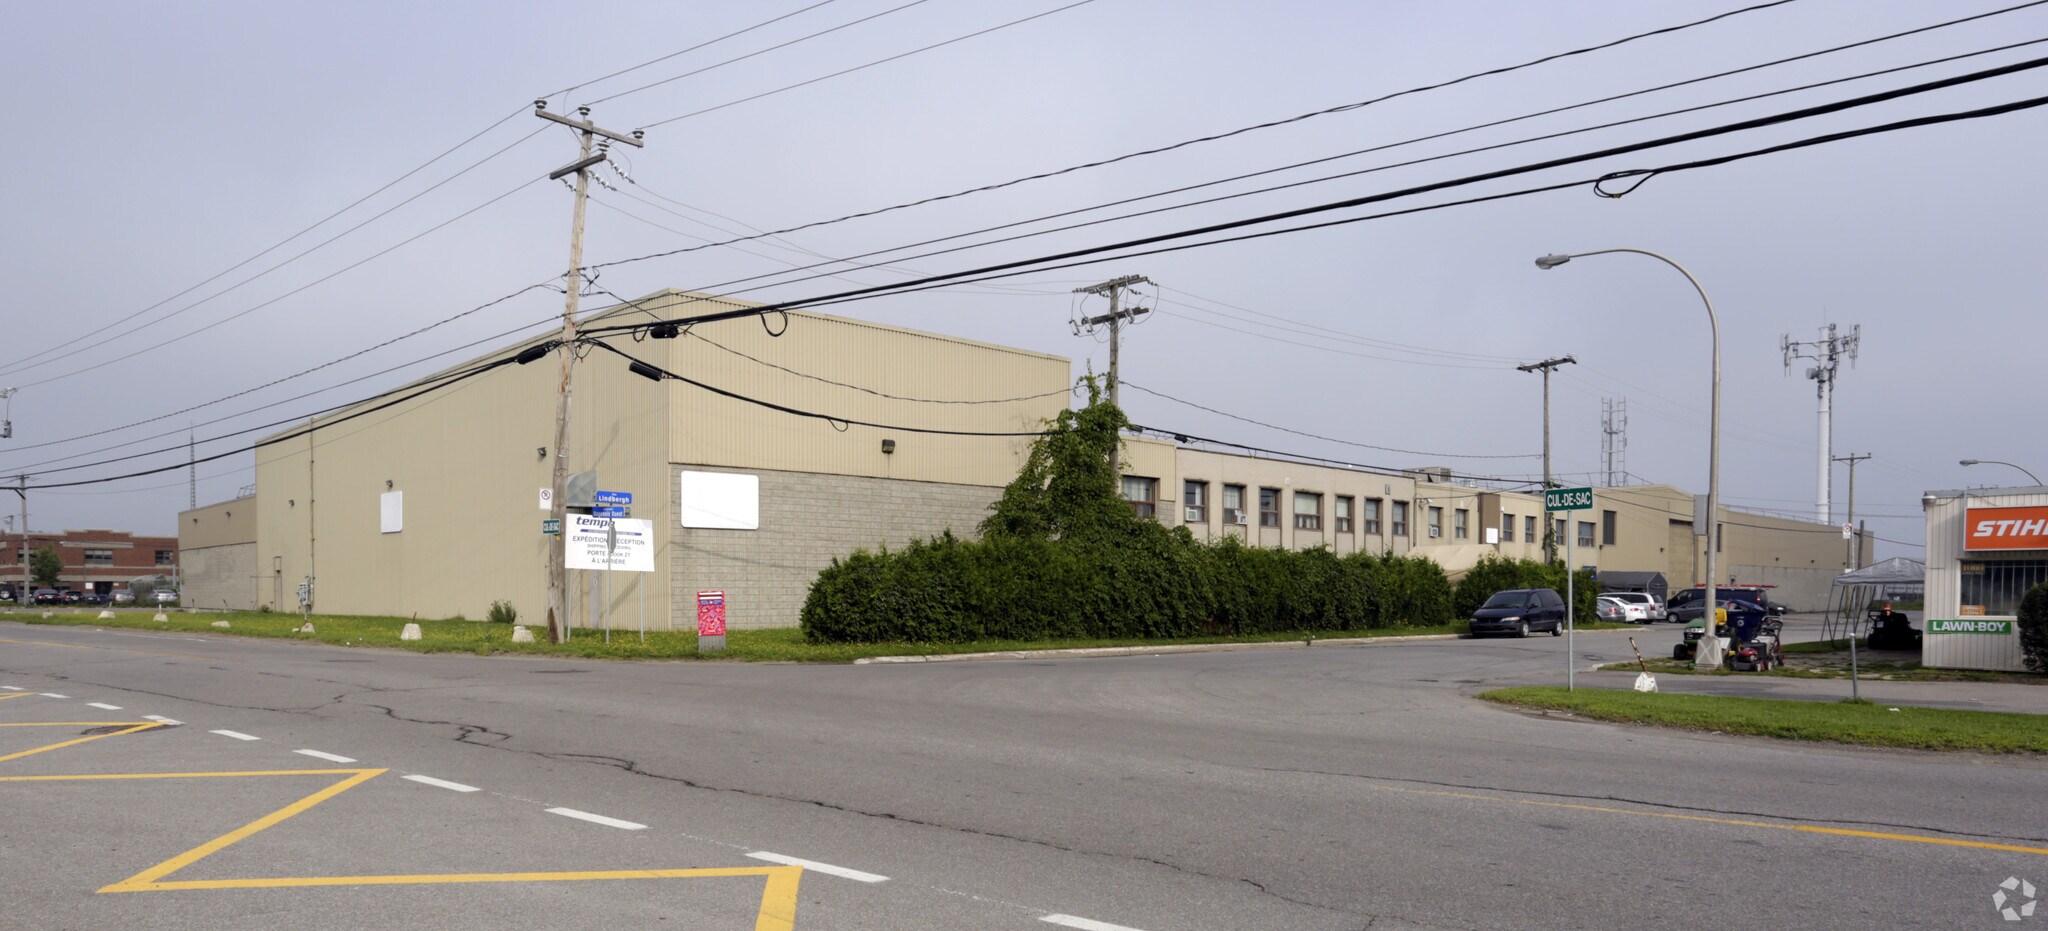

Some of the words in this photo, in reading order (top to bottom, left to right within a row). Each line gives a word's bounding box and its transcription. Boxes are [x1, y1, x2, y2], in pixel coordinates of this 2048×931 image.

[598, 495, 630, 504] Lindbergh
[1547, 491, 1591, 507] CUL-DE-SAC
[616, 537, 645, 546] ÉCEPTION
[1932, 621, 2006, 632] LAWN-BOY
